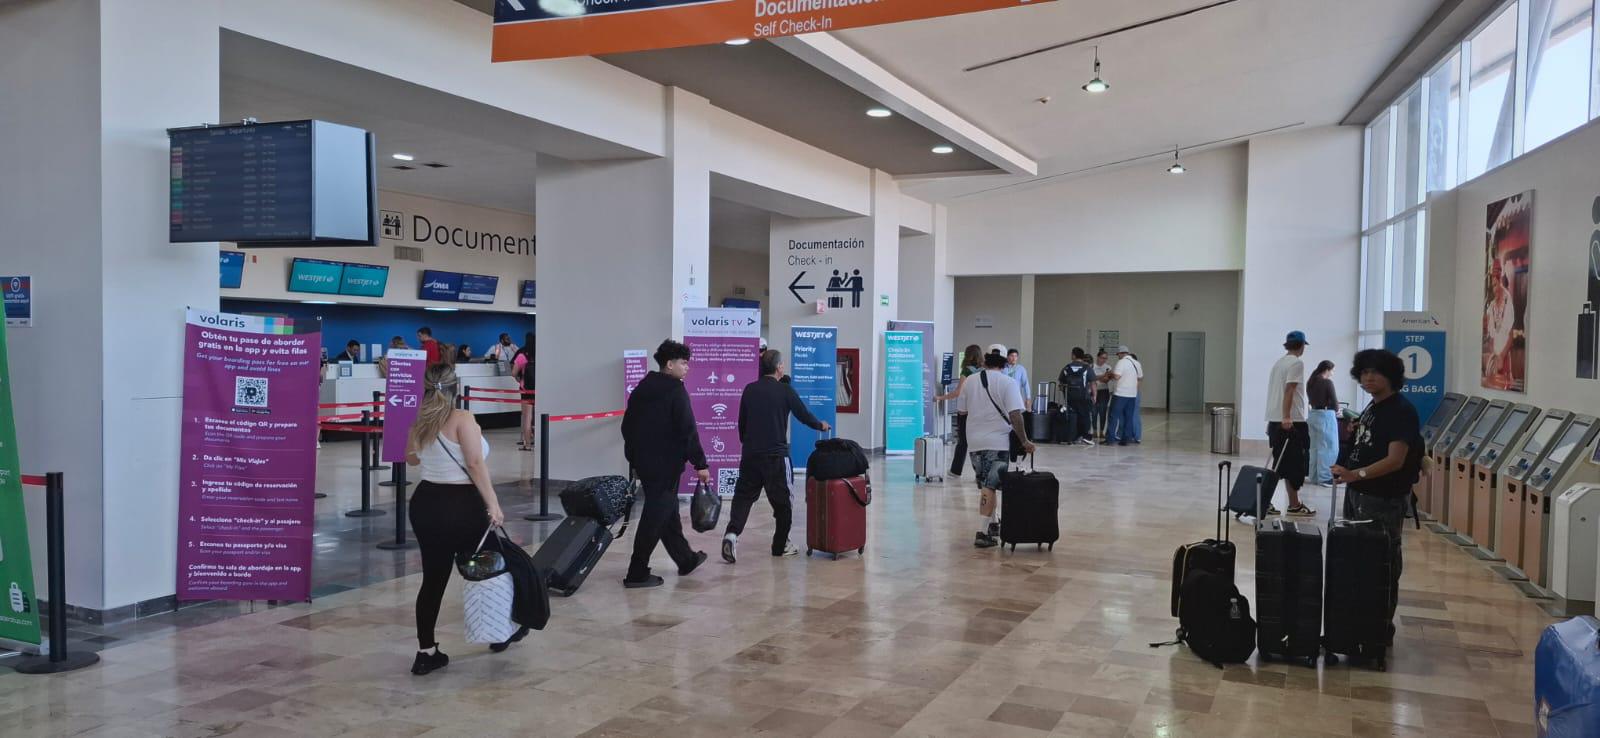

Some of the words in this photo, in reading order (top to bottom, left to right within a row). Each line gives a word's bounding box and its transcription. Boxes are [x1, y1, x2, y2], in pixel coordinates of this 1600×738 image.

[755, 0, 885, 17] Documenta
[754, 21, 776, 36] Self
[780, 16, 832, 34] Check-In
[788, 238, 864, 250] Documentación
[788, 256, 816, 265] Check
[825, 256, 832, 264] in
[298, 274, 326, 283] WESTJET
[348, 278, 373, 286] WESTJET
[200, 314, 245, 328] volaris
[691, 316, 729, 326] volaris
[201, 331, 227, 342] Obtén
[274, 338, 305, 346] abordar
[198, 341, 221, 350] gratis
[245, 346, 260, 355] app
[262, 348, 267, 356] y
[269, 346, 289, 355] evita
[291, 346, 307, 355] filas
[224, 356, 250, 365] boarding
[1408, 352, 1417, 373] 1
[237, 419, 257, 427] código
